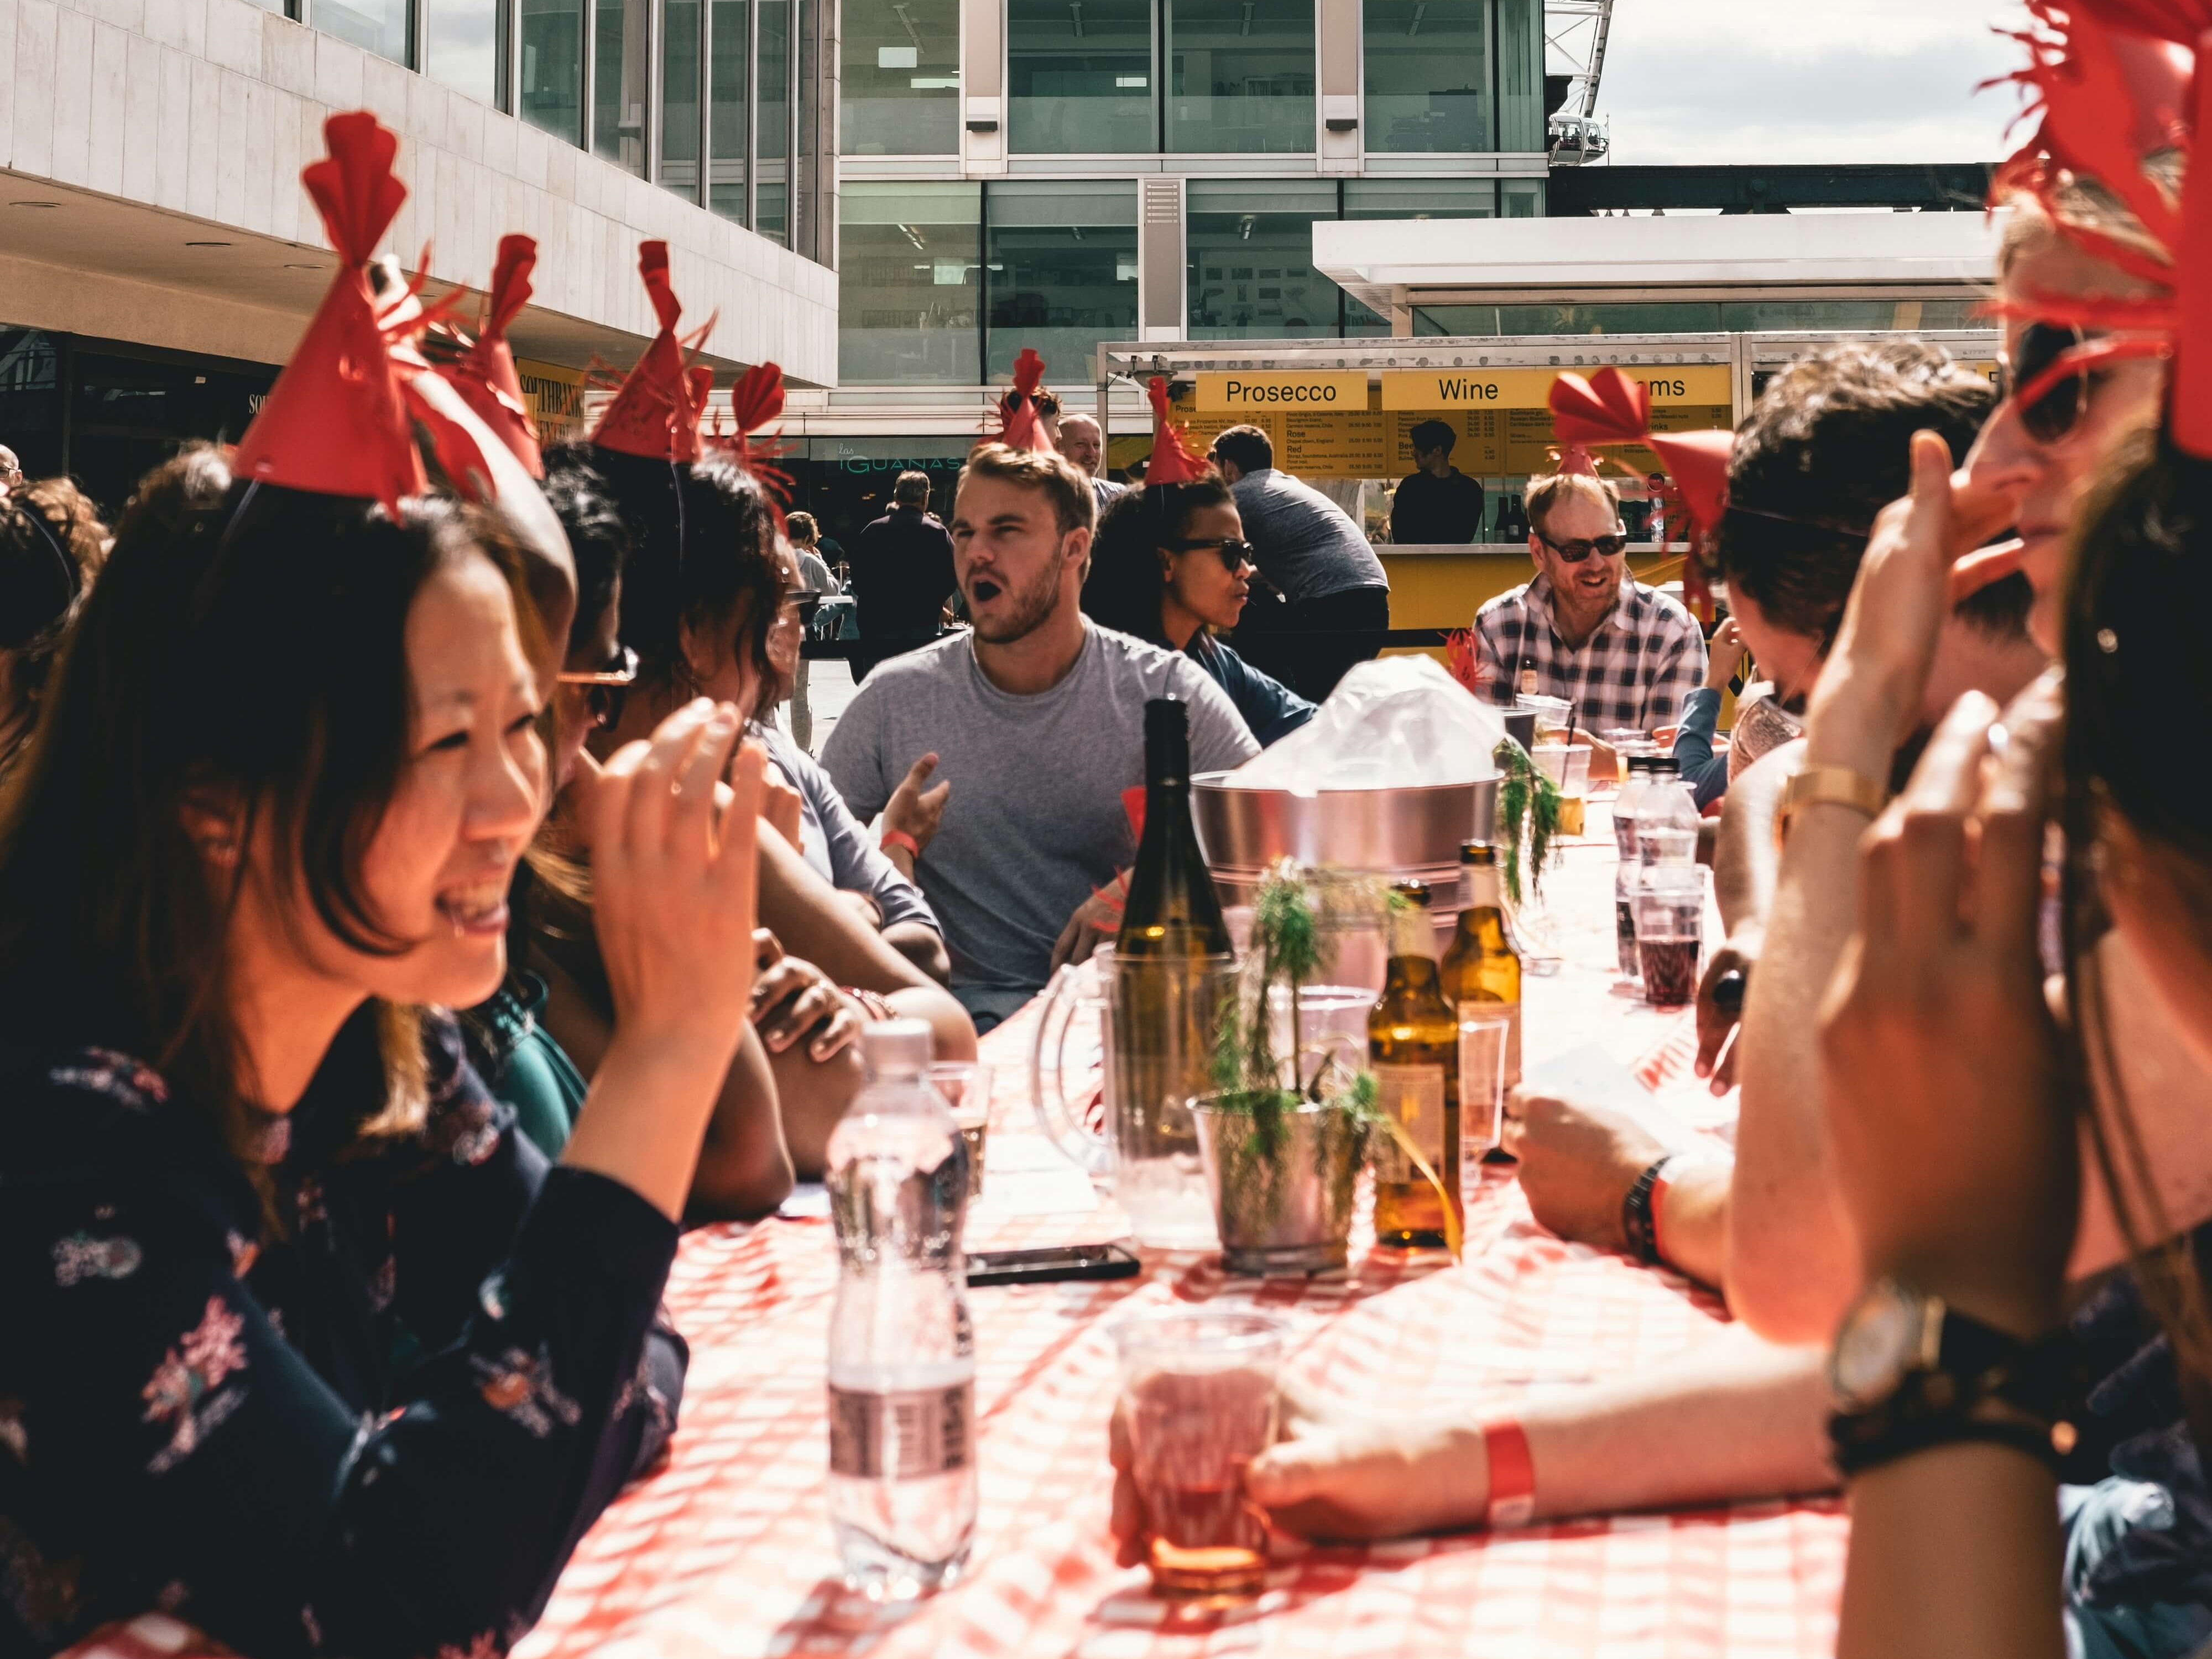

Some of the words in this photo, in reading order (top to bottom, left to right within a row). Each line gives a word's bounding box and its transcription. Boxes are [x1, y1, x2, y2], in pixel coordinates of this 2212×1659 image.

[1227, 381, 1337, 402] Prosecco
[1439, 378, 1499, 400] Wine
[1637, 380, 1685, 396] ms
[838, 443, 855, 455] las
